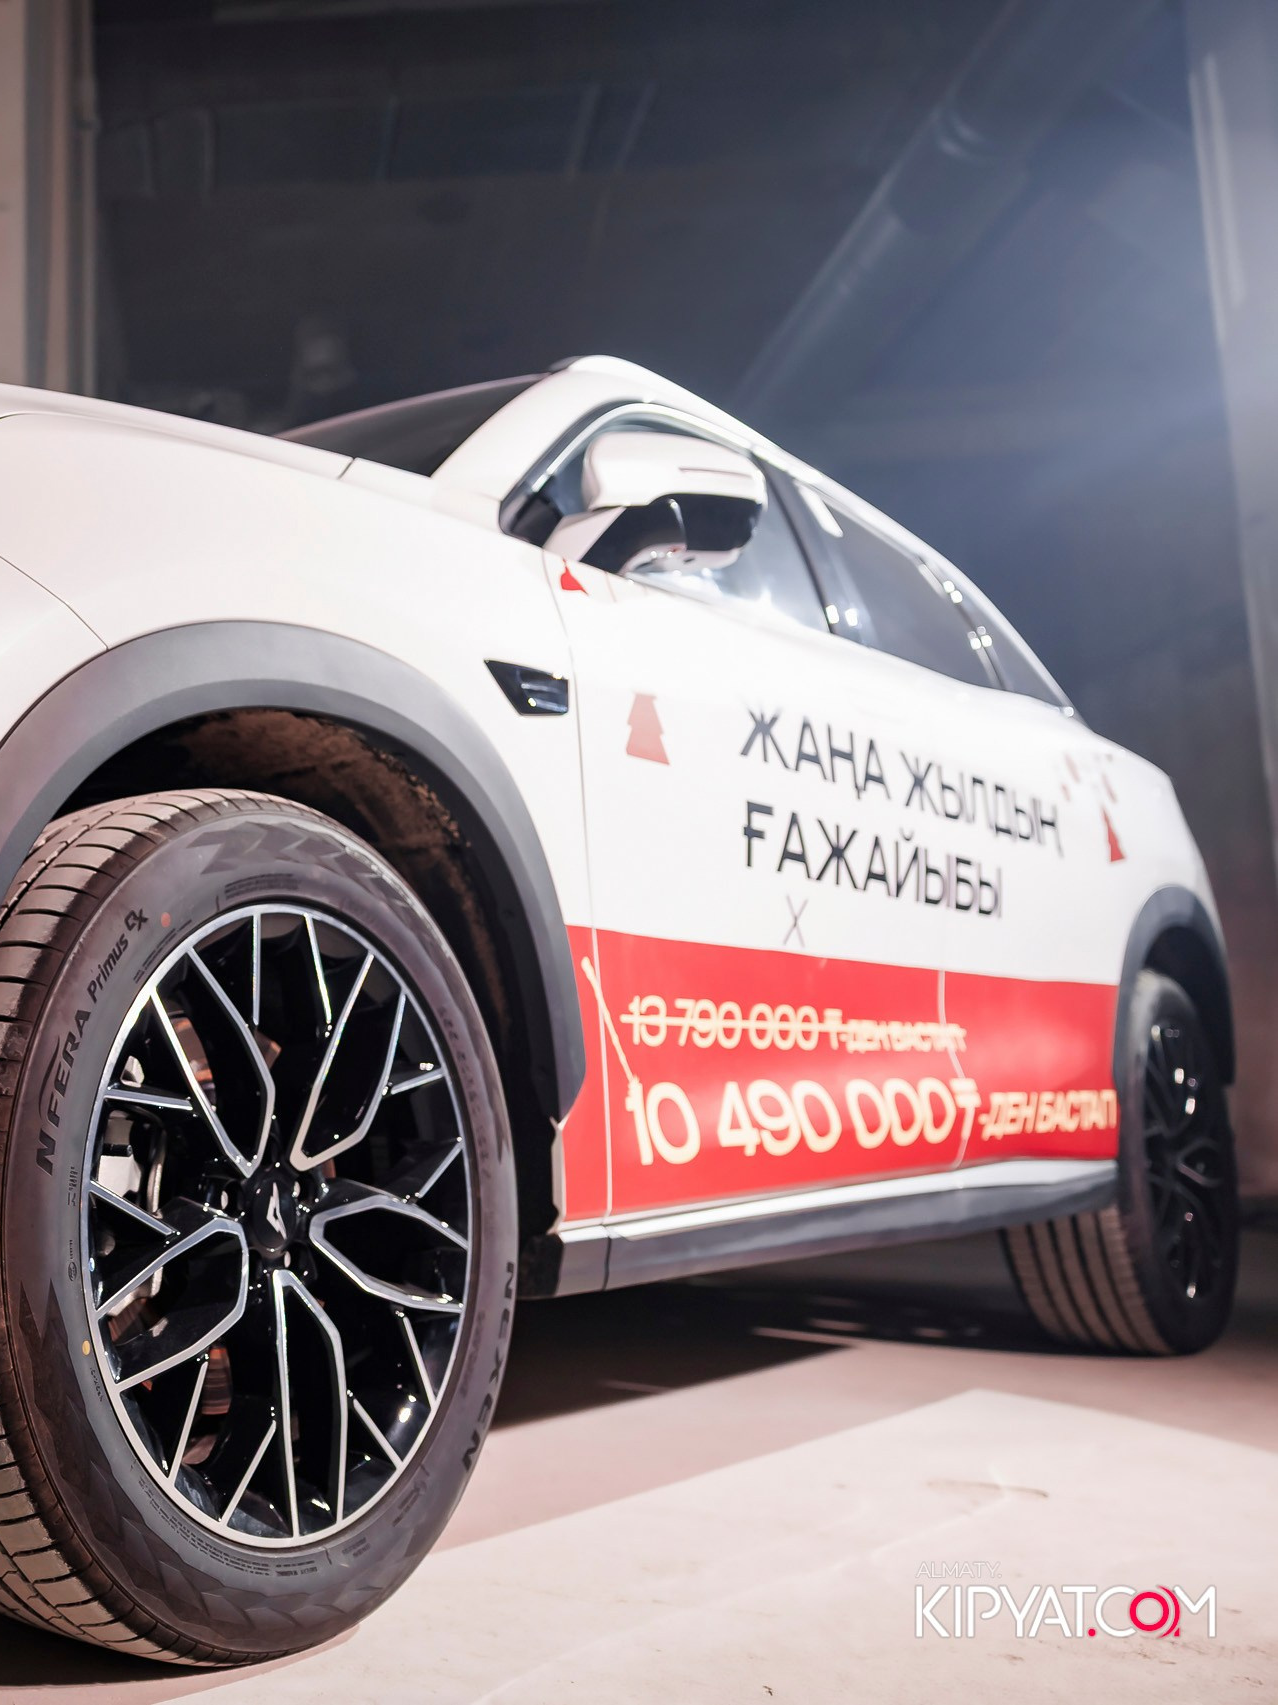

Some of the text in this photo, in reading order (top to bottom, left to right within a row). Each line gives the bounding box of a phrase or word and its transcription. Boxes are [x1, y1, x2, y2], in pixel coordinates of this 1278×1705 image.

[740, 708, 1065, 859] ЖАҢА ЖЫЛДЫҢ
[743, 800, 1003, 919] ҒАЖАЙЫБЫ
[87, 932, 130, 1004] Primus
[628, 995, 668, 1047] 13
[675, 998, 743, 1050] 790
[748, 1003, 820, 1052] 000
[625, 1080, 701, 1166] 10
[717, 1079, 843, 1157] 490
[461, 1261, 516, 1472] NEXEN
